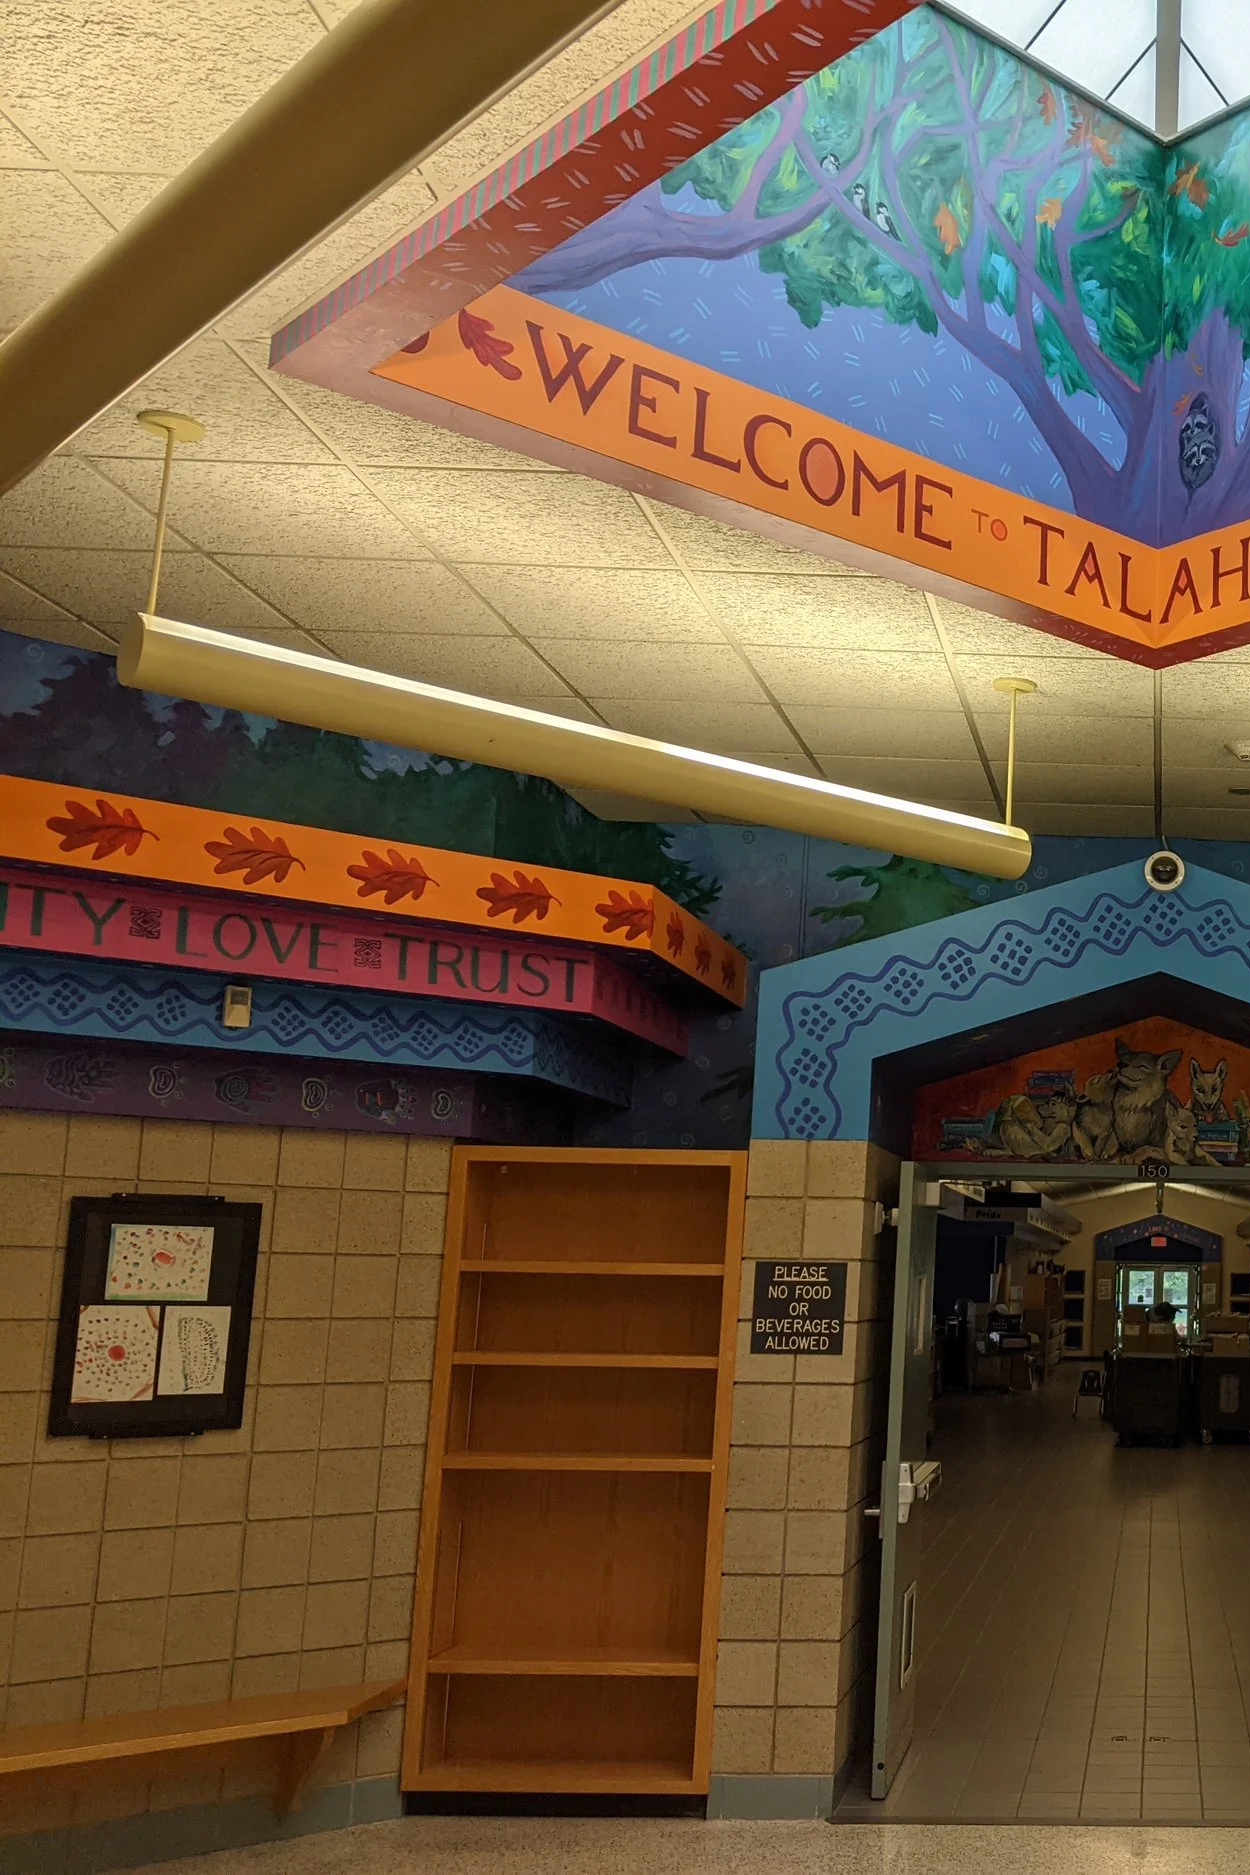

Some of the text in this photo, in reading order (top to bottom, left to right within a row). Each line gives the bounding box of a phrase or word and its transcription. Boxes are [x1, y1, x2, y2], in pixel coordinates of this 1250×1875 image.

[526, 319, 952, 551] WELCOME
[971, 508, 1008, 542] TO
[176, 906, 341, 973] LOVE
[379, 933, 591, 1003] TRUST
[1141, 1165, 1168, 1177] 150
[774, 1266, 828, 1280] PLEASE
[768, 1285, 832, 1299] NO FOOD
[789, 1302, 809, 1316] OR
[755, 1318, 840, 1333] BEVERAGES
[765, 1336, 829, 1350] ALLOWED
